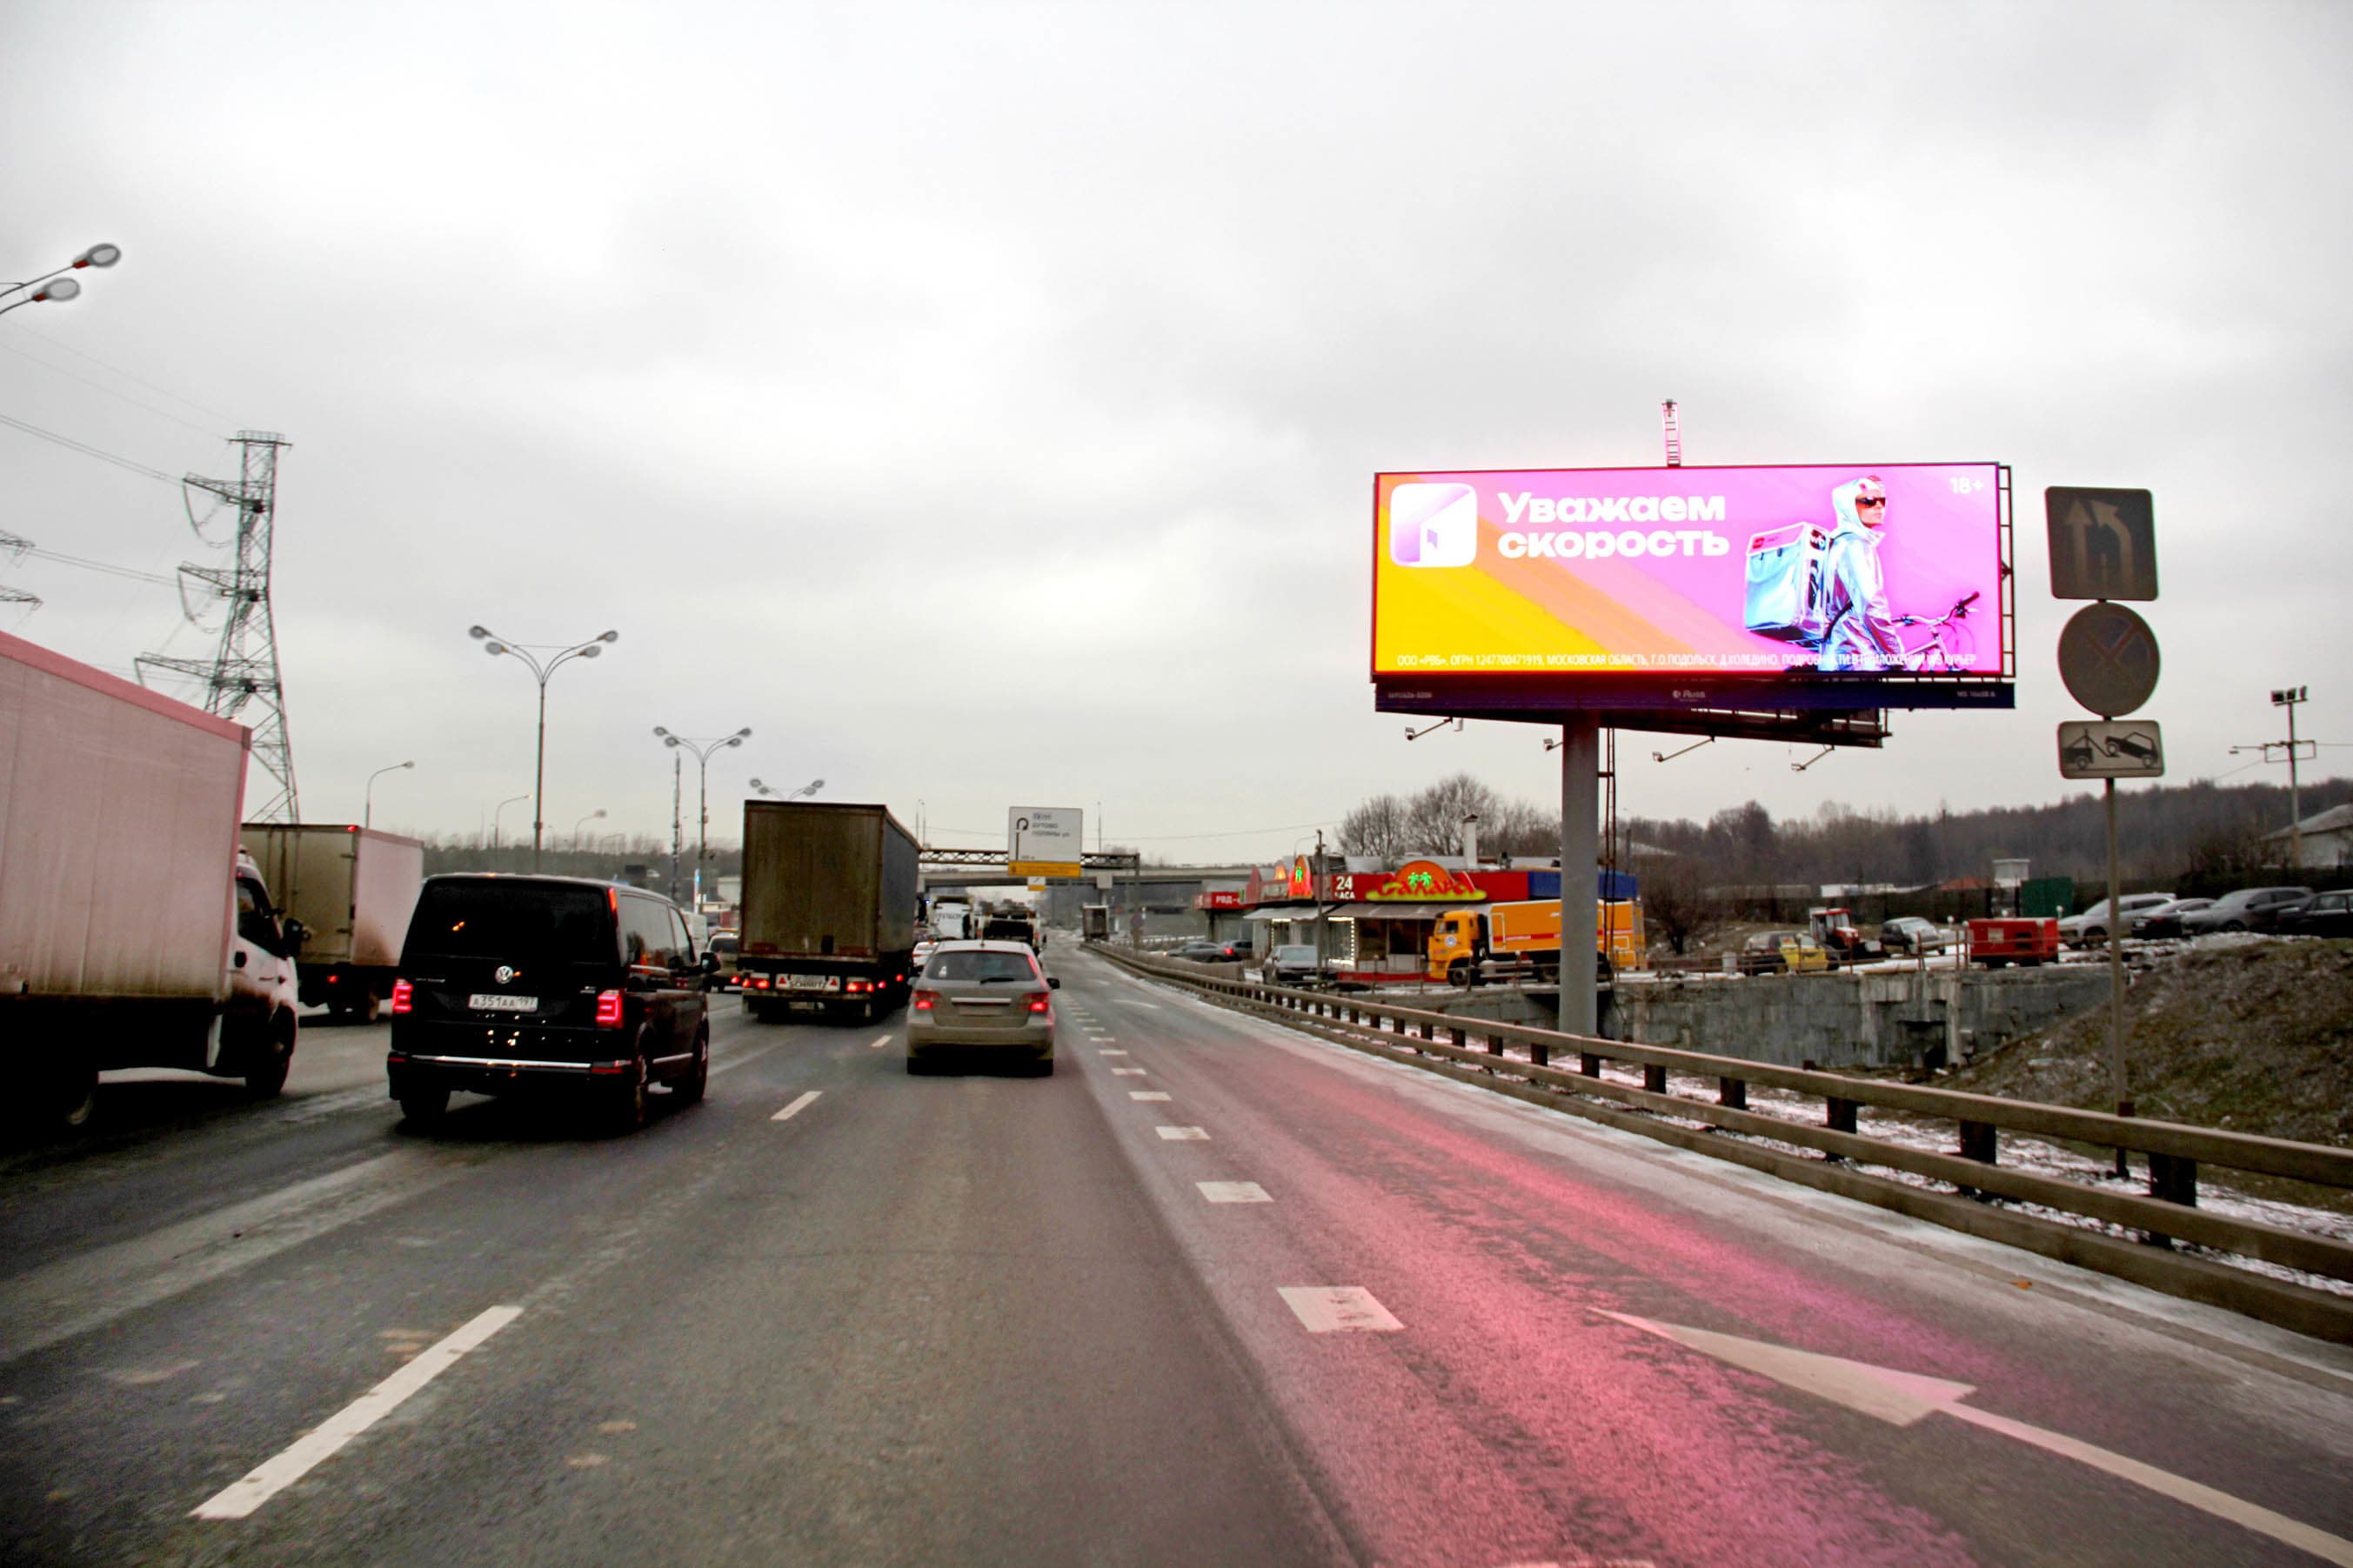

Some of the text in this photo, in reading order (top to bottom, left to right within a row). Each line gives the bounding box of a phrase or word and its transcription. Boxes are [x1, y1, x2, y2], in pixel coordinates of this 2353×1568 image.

[1949, 477, 1984, 494] 18+
[1497, 491, 1726, 524] Уважаем
[1497, 530, 1730, 559] скорость
[1397, 654, 1418, 666] ООО
[1450, 654, 1474, 666] ОГРН
[1547, 654, 1606, 666] МОСКОВСКАЯ
[1781, 654, 1849, 667] ПОДРОБТИ
[1335, 876, 1354, 891] 24
